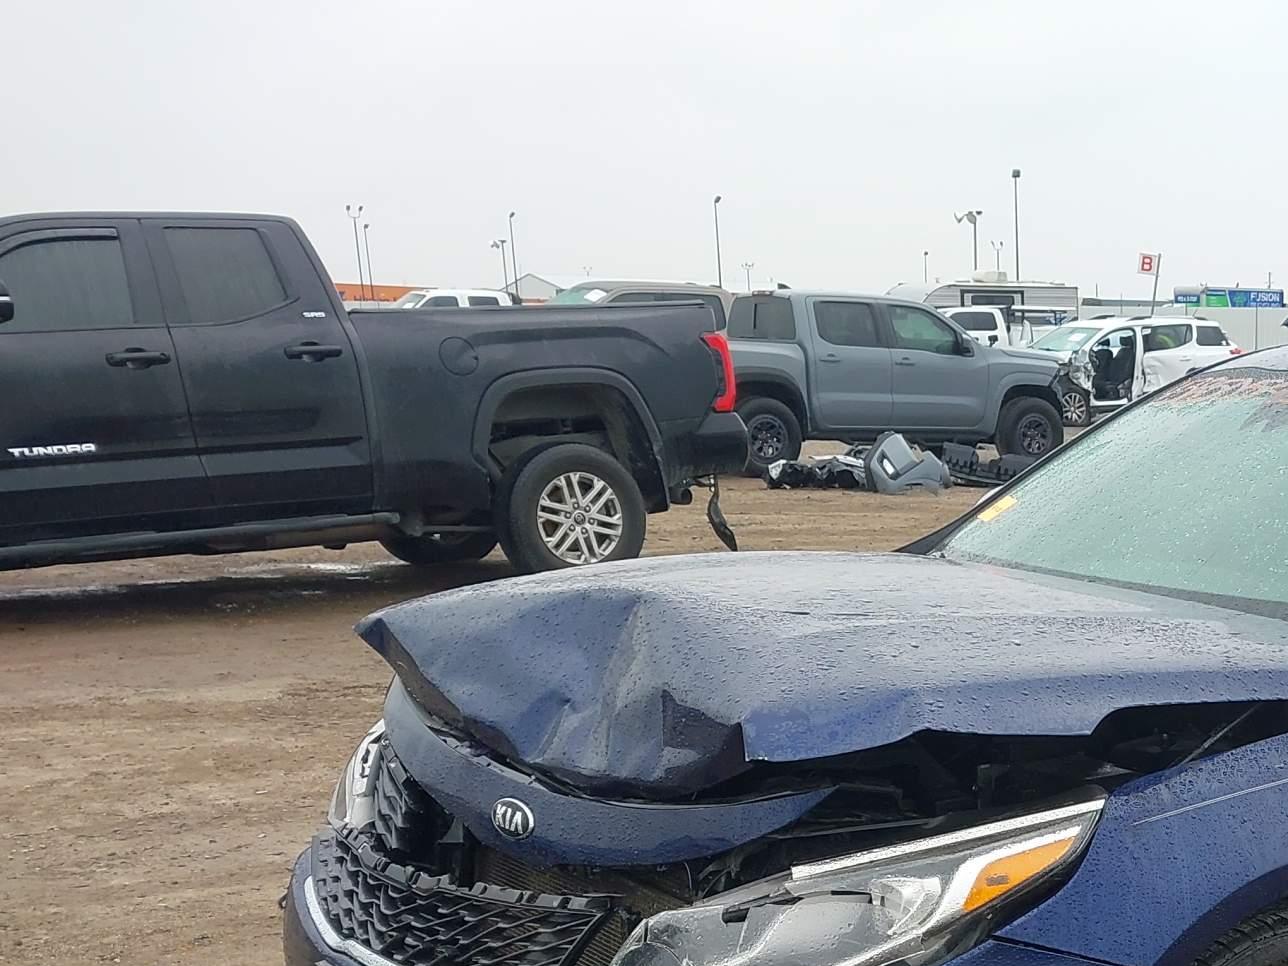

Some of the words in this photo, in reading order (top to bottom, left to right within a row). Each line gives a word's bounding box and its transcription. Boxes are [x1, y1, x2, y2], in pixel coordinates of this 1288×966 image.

[1141, 256, 1153, 271] B
[1250, 292, 1280, 302] FUSION
[7, 443, 96, 457] TUNDRA
[495, 803, 523, 834] KIA
